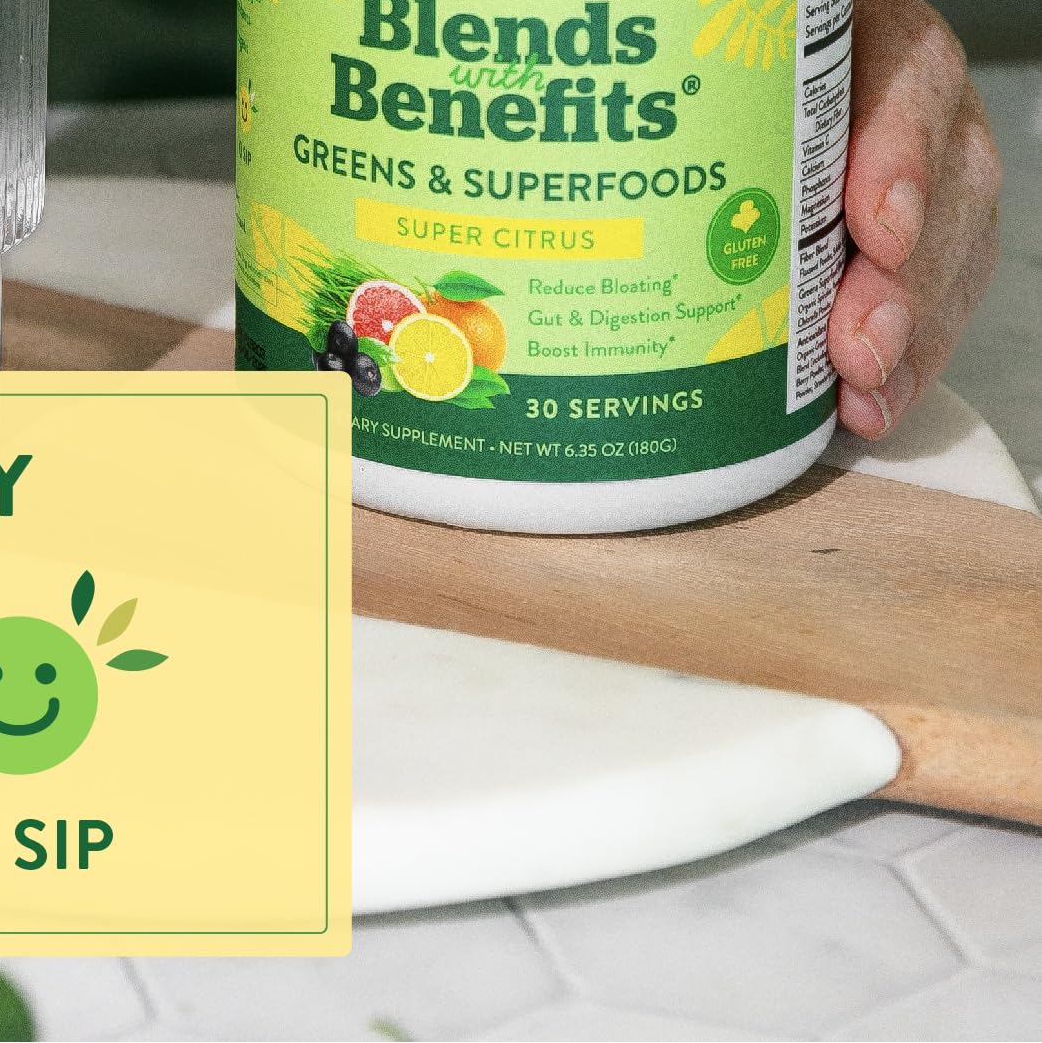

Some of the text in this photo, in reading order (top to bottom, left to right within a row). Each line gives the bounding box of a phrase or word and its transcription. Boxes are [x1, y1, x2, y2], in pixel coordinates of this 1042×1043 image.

[806, 0, 830, 18] Serving
[449, 52, 545, 91] with
[804, 82, 826, 98] Calories
[804, 103, 818, 118] Total
[293, 134, 727, 202] GREENS & SUPERFOODS
[397, 217, 595, 250] SUPER CITRUS
[723, 234, 767, 255] GLUTEN
[730, 256, 759, 270] FREE
[529, 279, 596, 295] Reduce
[528, 310, 562, 326] Gut
[569, 310, 583, 327] &
[590, 307, 671, 331] Digestion
[527, 340, 579, 357] Boost
[526, 389, 703, 419] 30 SERVINGS
[382, 422, 486, 452] SUPPLEMENT
[499, 440, 533, 456] NET
[536, 443, 561, 457] WT
[564, 442, 597, 458] 6.35
[602, 442, 625, 457] OZ
[628, 437, 677, 456] (180G)
